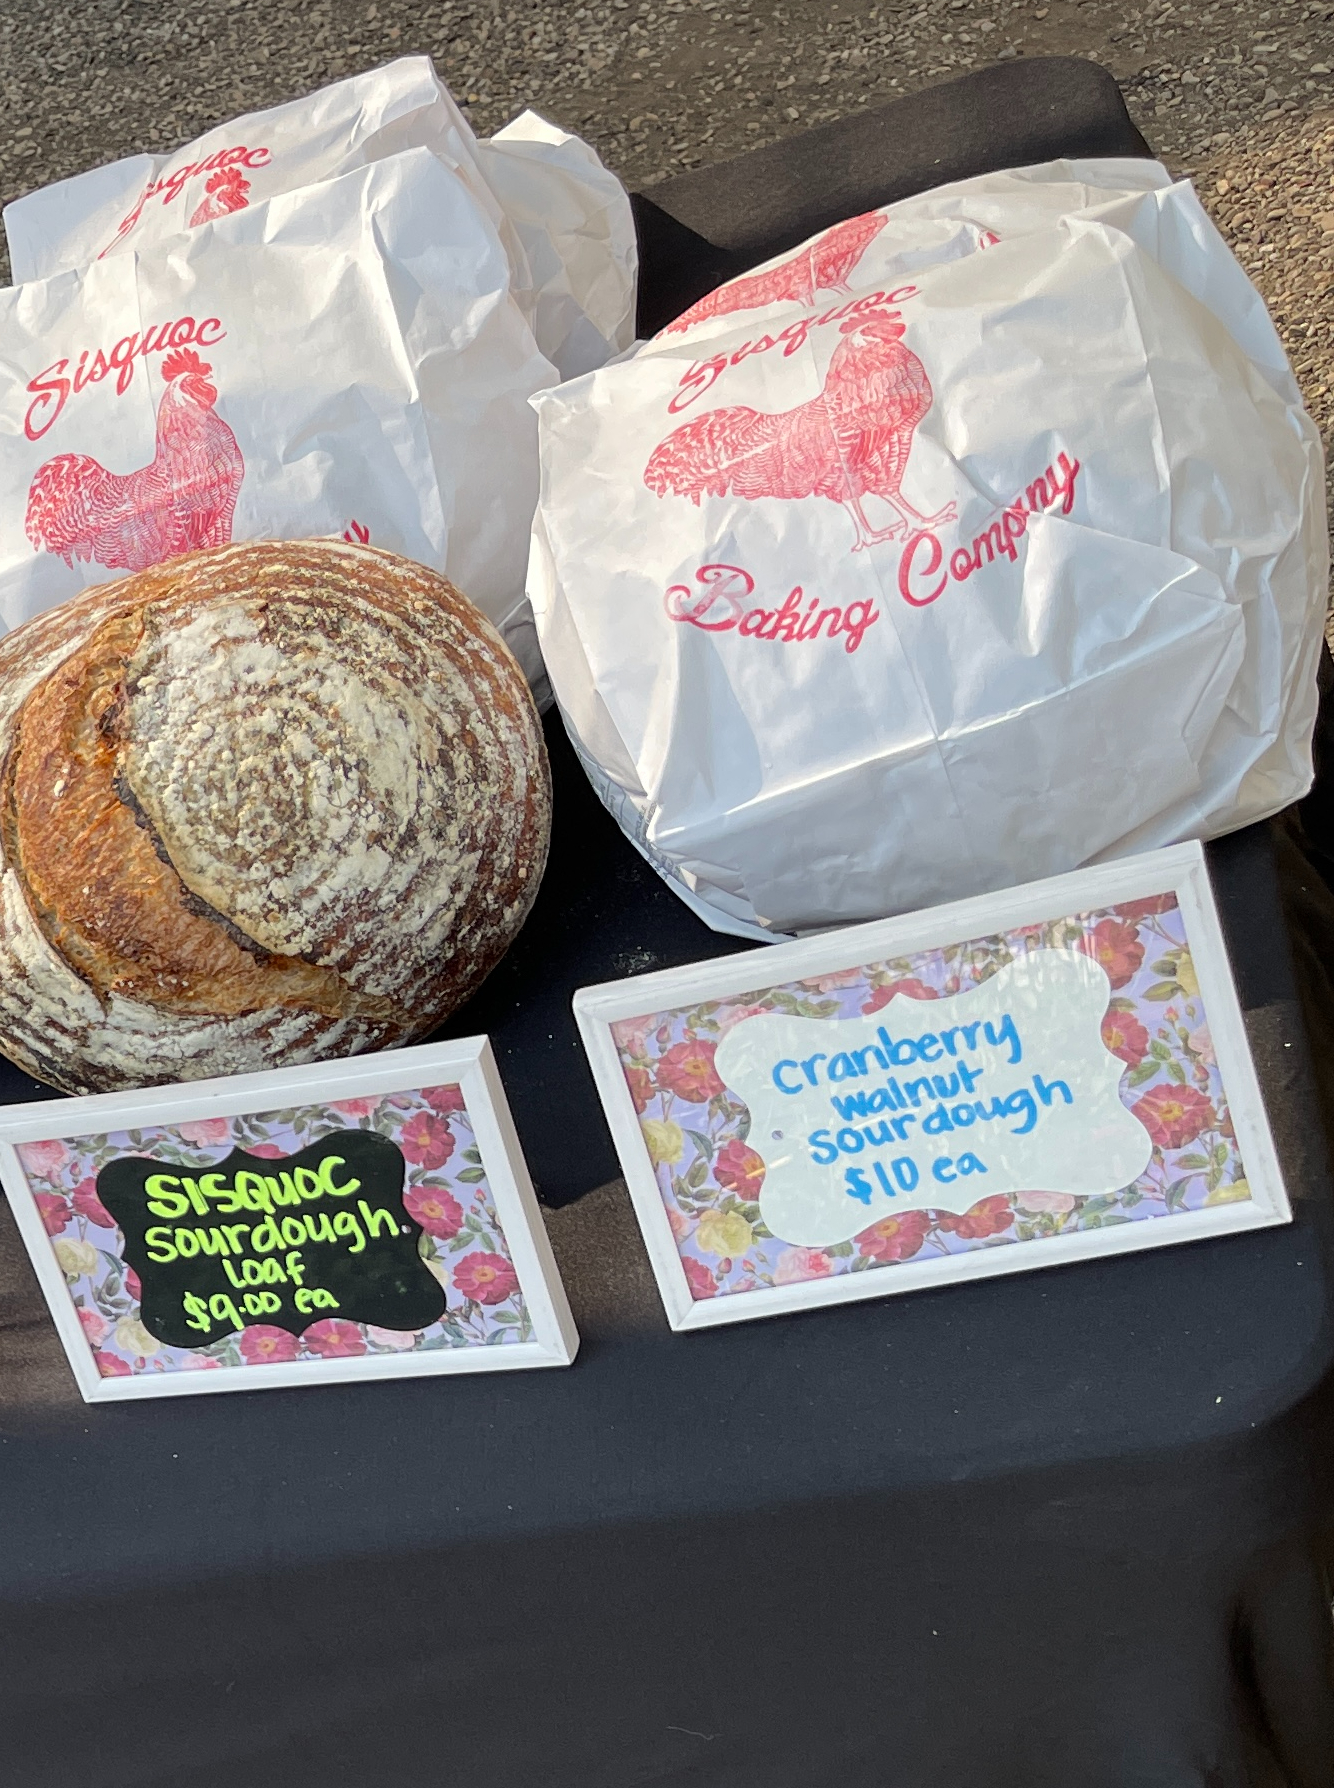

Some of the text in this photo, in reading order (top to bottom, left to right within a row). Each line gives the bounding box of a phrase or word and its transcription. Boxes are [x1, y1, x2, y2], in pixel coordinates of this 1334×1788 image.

[24, 317, 227, 442] Sisquoc
[668, 285, 922, 415] Sisquoc
[664, 451, 1080, 654] Baking Company
[831, 1060, 984, 1122] walnut
[844, 1150, 989, 1205] $10 ea
[183, 1288, 340, 1333] $9.00 ea
